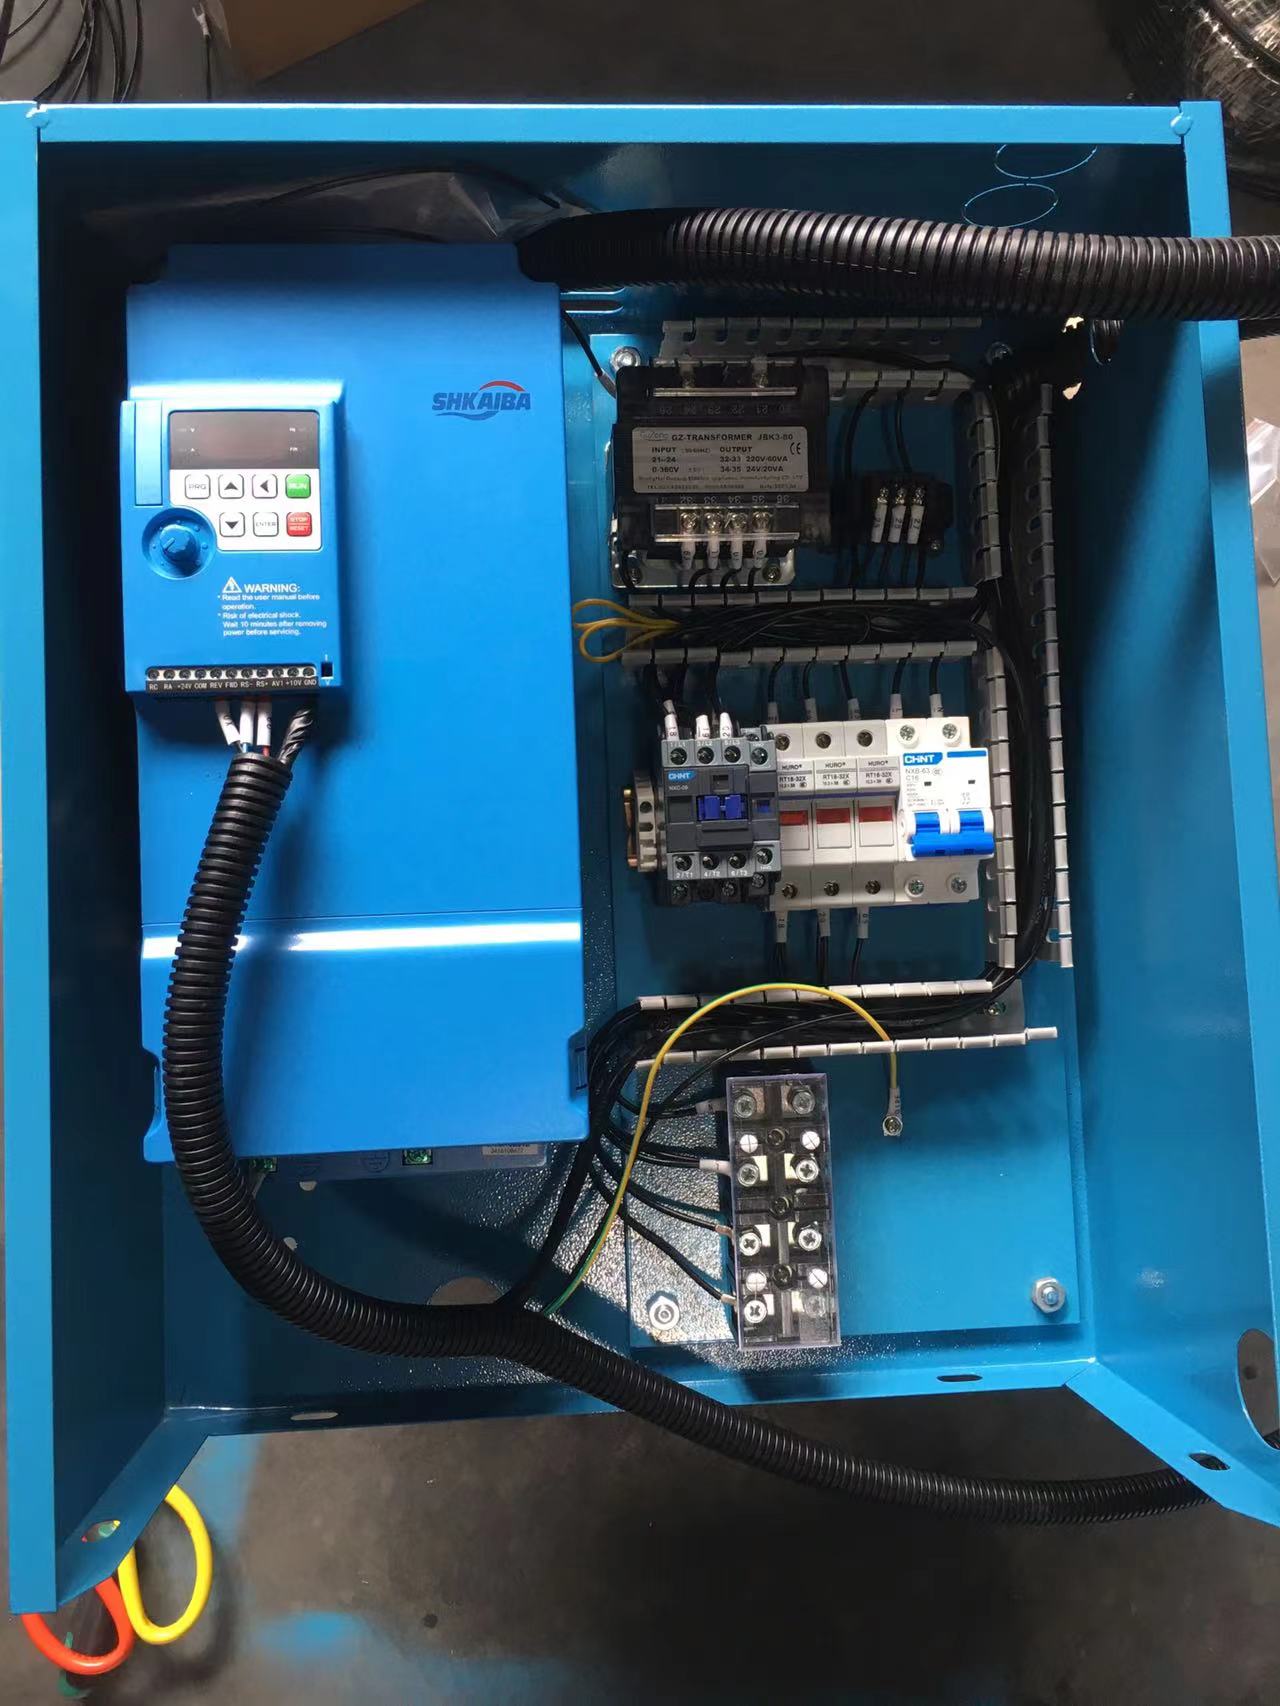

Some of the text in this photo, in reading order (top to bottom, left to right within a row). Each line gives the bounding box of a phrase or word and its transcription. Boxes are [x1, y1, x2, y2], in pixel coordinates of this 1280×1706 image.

[431, 392, 531, 411] SHKAIBA
[671, 433, 753, 442] GZ-TRANSFORMER
[243, 583, 301, 593] WARNING:
[222, 603, 256, 611] operation.
[194, 682, 208, 690] COM
[209, 681, 223, 689] REV
[225, 681, 239, 689] FWD
[285, 679, 302, 687] +10V
[303, 678, 317, 686] GND
